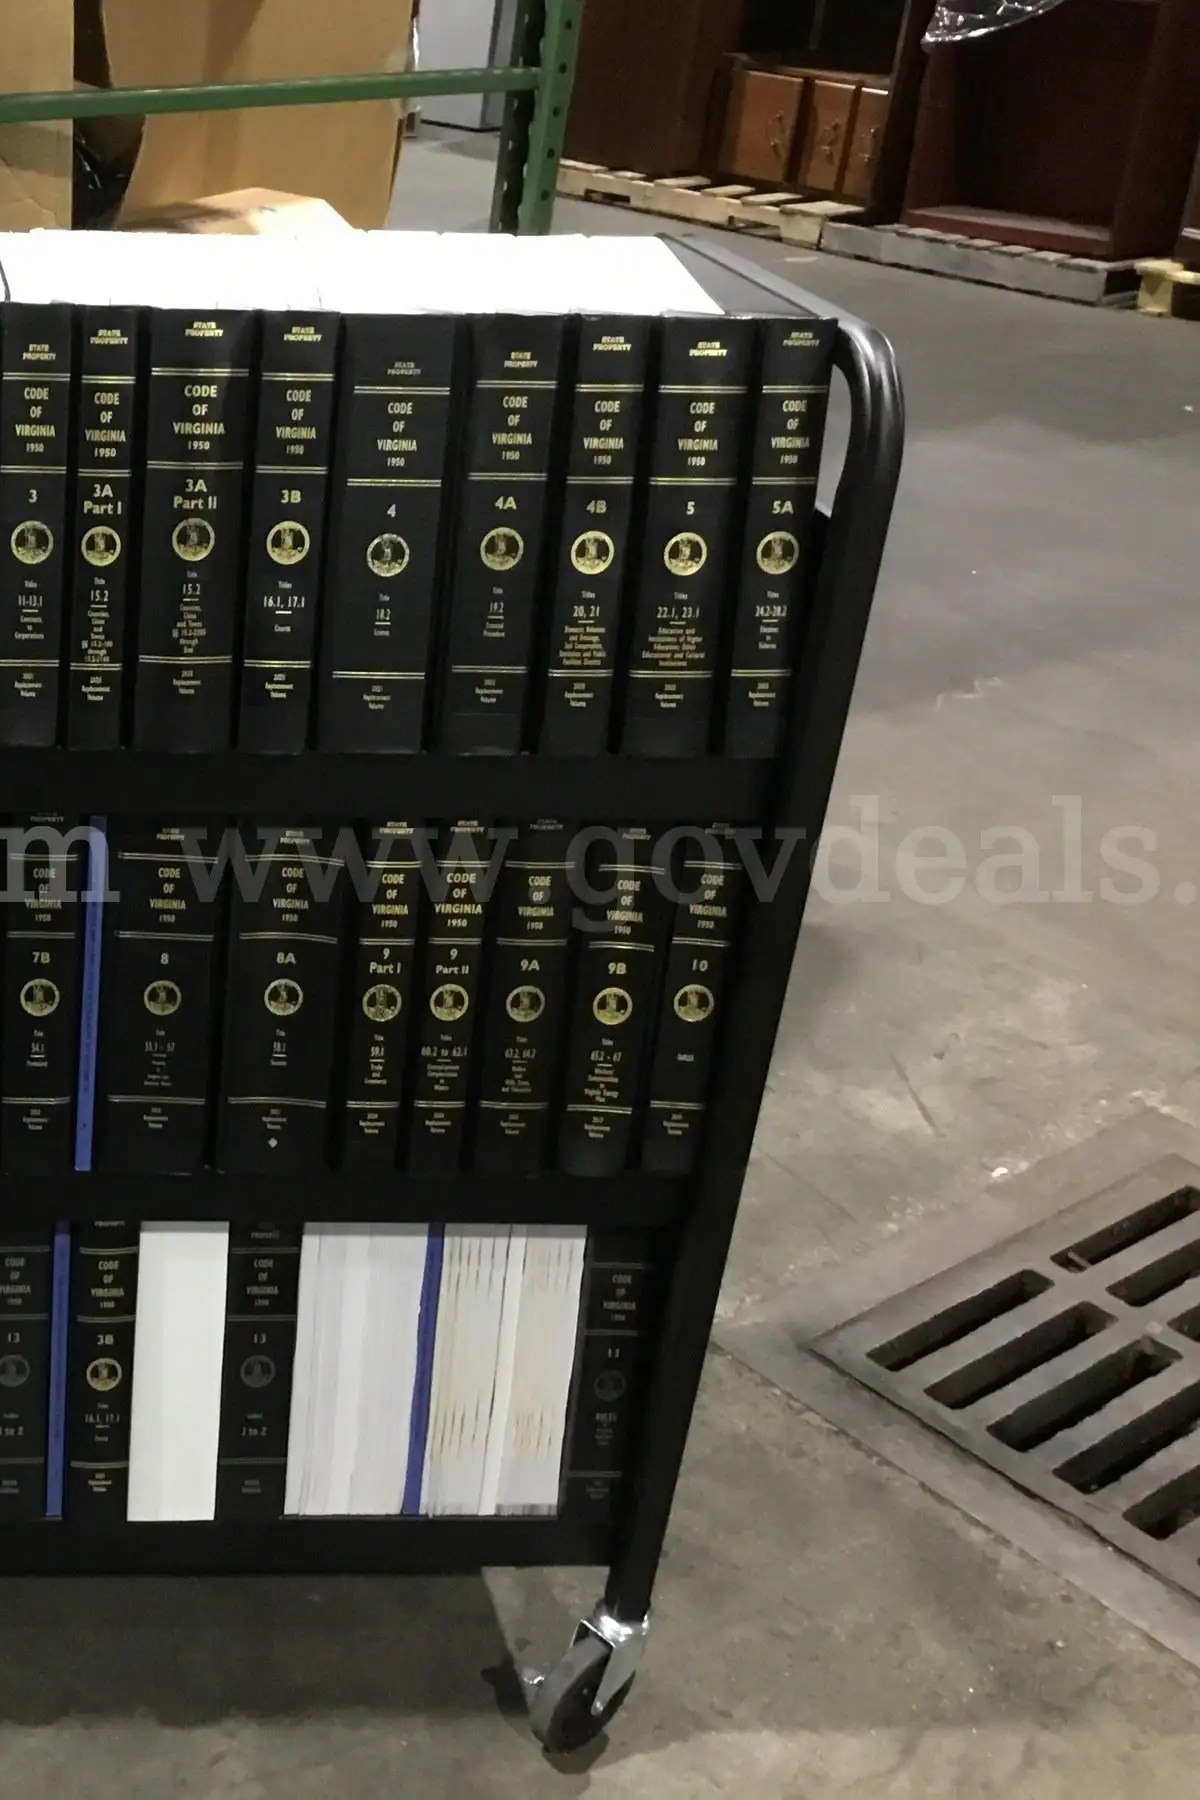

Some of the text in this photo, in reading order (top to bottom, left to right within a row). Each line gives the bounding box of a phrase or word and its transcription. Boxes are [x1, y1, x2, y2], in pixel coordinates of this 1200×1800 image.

[24, 388, 48, 399] CODE
[185, 385, 217, 397] CODE
[287, 390, 311, 402] CODE
[95, 393, 119, 405] CODE
[503, 396, 528, 408] CODE
[30, 406, 41, 417] OF
[193, 404, 208, 415] OF
[388, 403, 412, 414] CODE
[595, 401, 620, 412] CODE
[690, 402, 714, 414] CODE
[783, 400, 806, 412] CODE
[100, 412, 112, 423] OF
[292, 409, 304, 420] OF
[508, 415, 520, 426] OF
[600, 419, 612, 430] OF
[787, 418, 798, 430] OF
[16, 424, 55, 436] VIRGINIA
[173, 423, 224, 434] VIRGINIA
[393, 421, 404, 432] OF
[695, 421, 707, 432] OF
[85, 430, 126, 442] VIRGINIA
[276, 427, 316, 439] VIRGINIA
[492, 433, 532, 444] VIRGINIA
[378, 440, 417, 451] VIRGINIA
[584, 438, 623, 449] VIRGINIA
[678, 439, 717, 450] VIRGINIA
[771, 437, 809, 448] VIRGINIA
[94, 484, 113, 497] 3A
[186, 479, 207, 492] 3A
[29, 490, 37, 502] 3
[281, 490, 301, 503] 3B
[84, 501, 113, 514] Part
[174, 496, 203, 509] Part
[495, 497, 516, 509] 4A
[587, 500, 606, 513] 4B
[687, 502, 694, 514] 5
[773, 501, 793, 513] 5A
[387, 504, 395, 517] 4
[158, 868, 180, 878] CODE
[282, 867, 303, 878] CODE
[447, 873, 476, 883] CODE
[382, 874, 404, 884] CODE
[529, 876, 551, 887] CODE
[701, 874, 724, 885] CODE
[163, 883, 174, 893] OF
[286, 883, 297, 893] OF
[617, 880, 640, 891] CODE
[387, 889, 397, 899] OF
[453, 888, 466, 898] OF
[704, 889, 716, 899] OF
[150, 899, 185, 909] VIRGINIA
[273, 898, 308, 909] VIRGINIA
[435, 904, 482, 914] VIRGINIA
[607, 910, 642, 921] VIRGINIA
[690, 904, 726, 916] VIRGINIA
[33, 952, 50, 963] 7B
[161, 953, 168, 964] 8
[277, 952, 296, 963] 8A
[384, 948, 390, 959] 9
[450, 949, 457, 959] 9
[370, 962, 393, 973] Part
[521, 959, 539, 970] 9A
[608, 963, 626, 974] 9B
